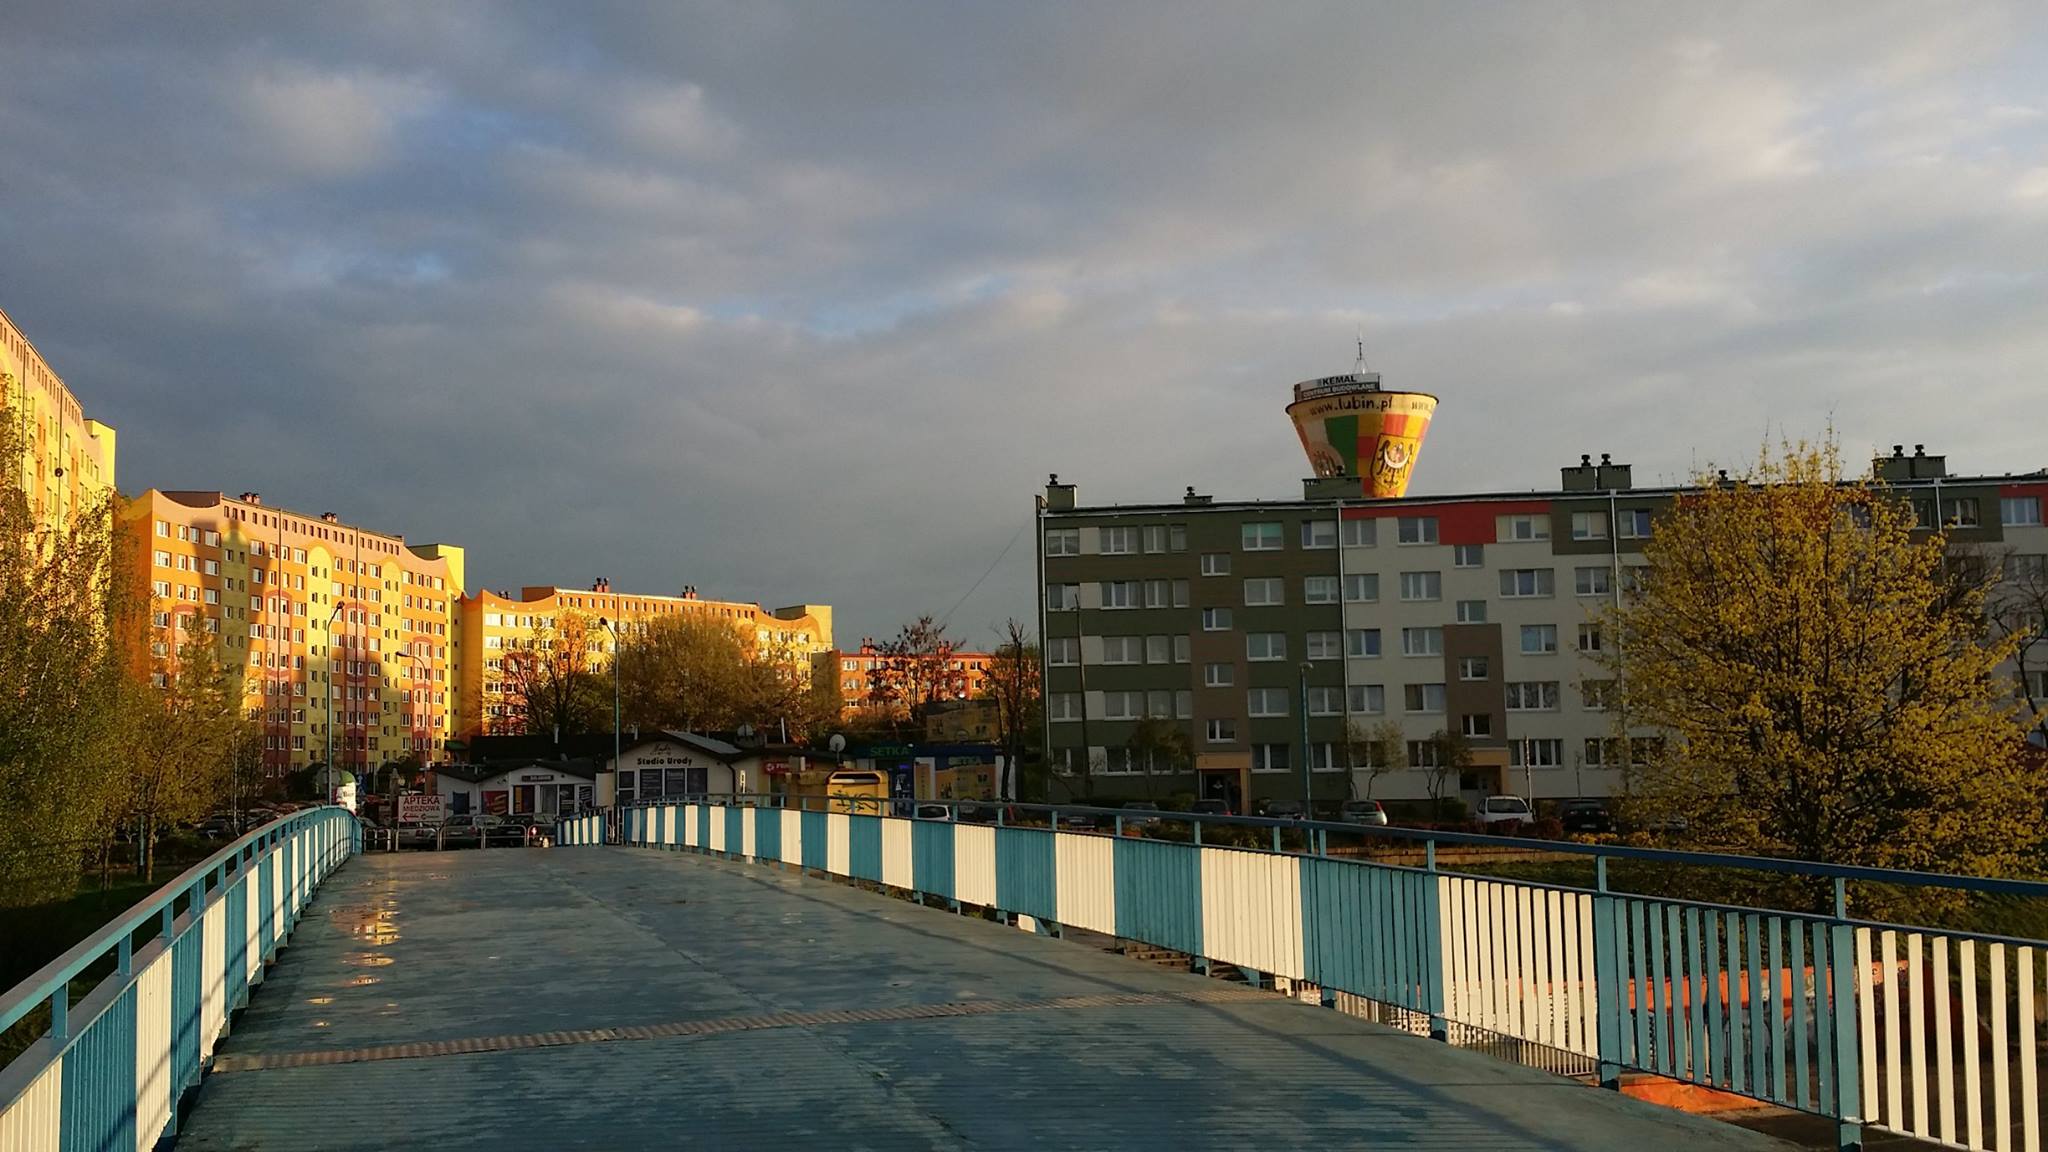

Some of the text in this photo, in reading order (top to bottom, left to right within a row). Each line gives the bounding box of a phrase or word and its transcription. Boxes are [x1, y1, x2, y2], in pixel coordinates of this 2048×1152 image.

[1322, 375, 1357, 386] KEMAL
[1303, 387, 1331, 399] CENTRUM
[1310, 396, 1392, 415] www.lubin.pl
[637, 756, 692, 766] Studio Urody
[403, 796, 440, 805] APTEKA
